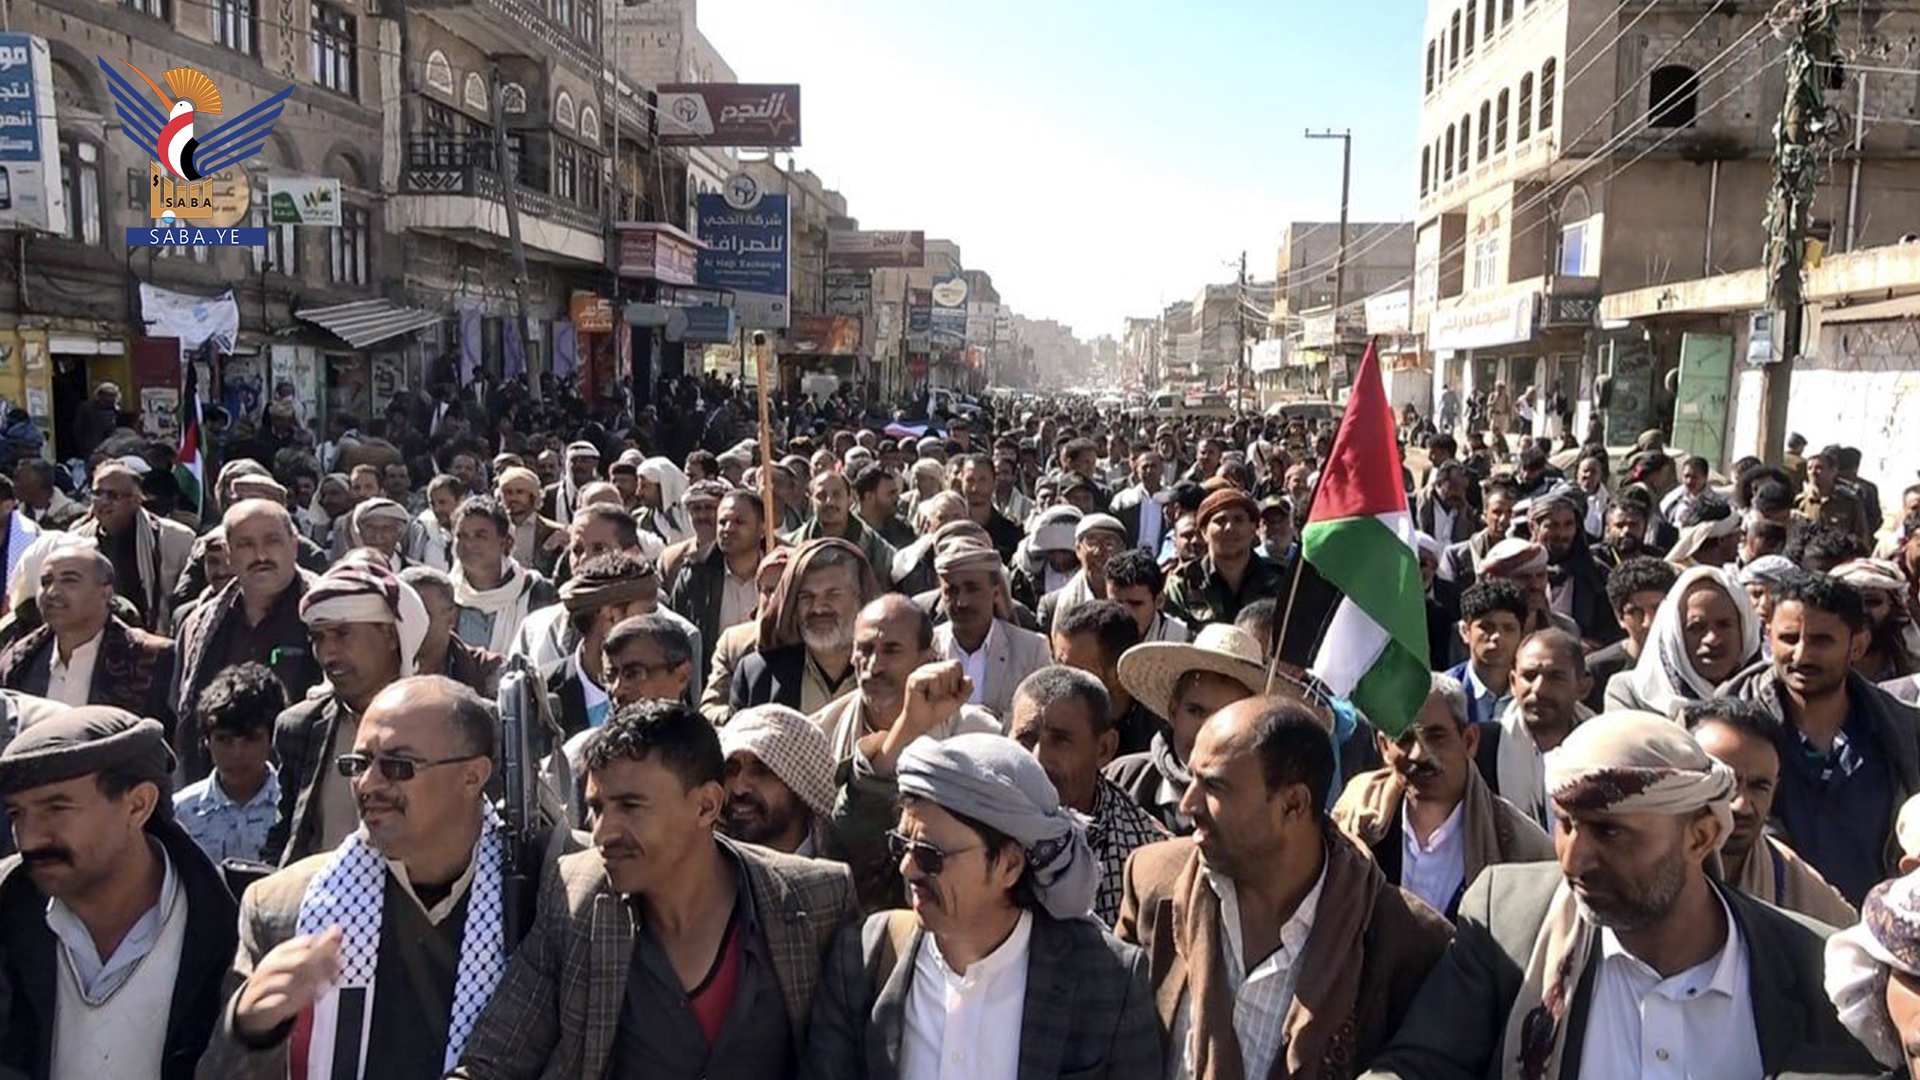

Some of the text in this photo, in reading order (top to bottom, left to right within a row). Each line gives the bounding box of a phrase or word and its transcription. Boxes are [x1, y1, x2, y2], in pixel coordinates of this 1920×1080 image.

[720, 92, 786, 123] النجم
[746, 213, 782, 228] شركة
[704, 233, 783, 255] للصرافة
